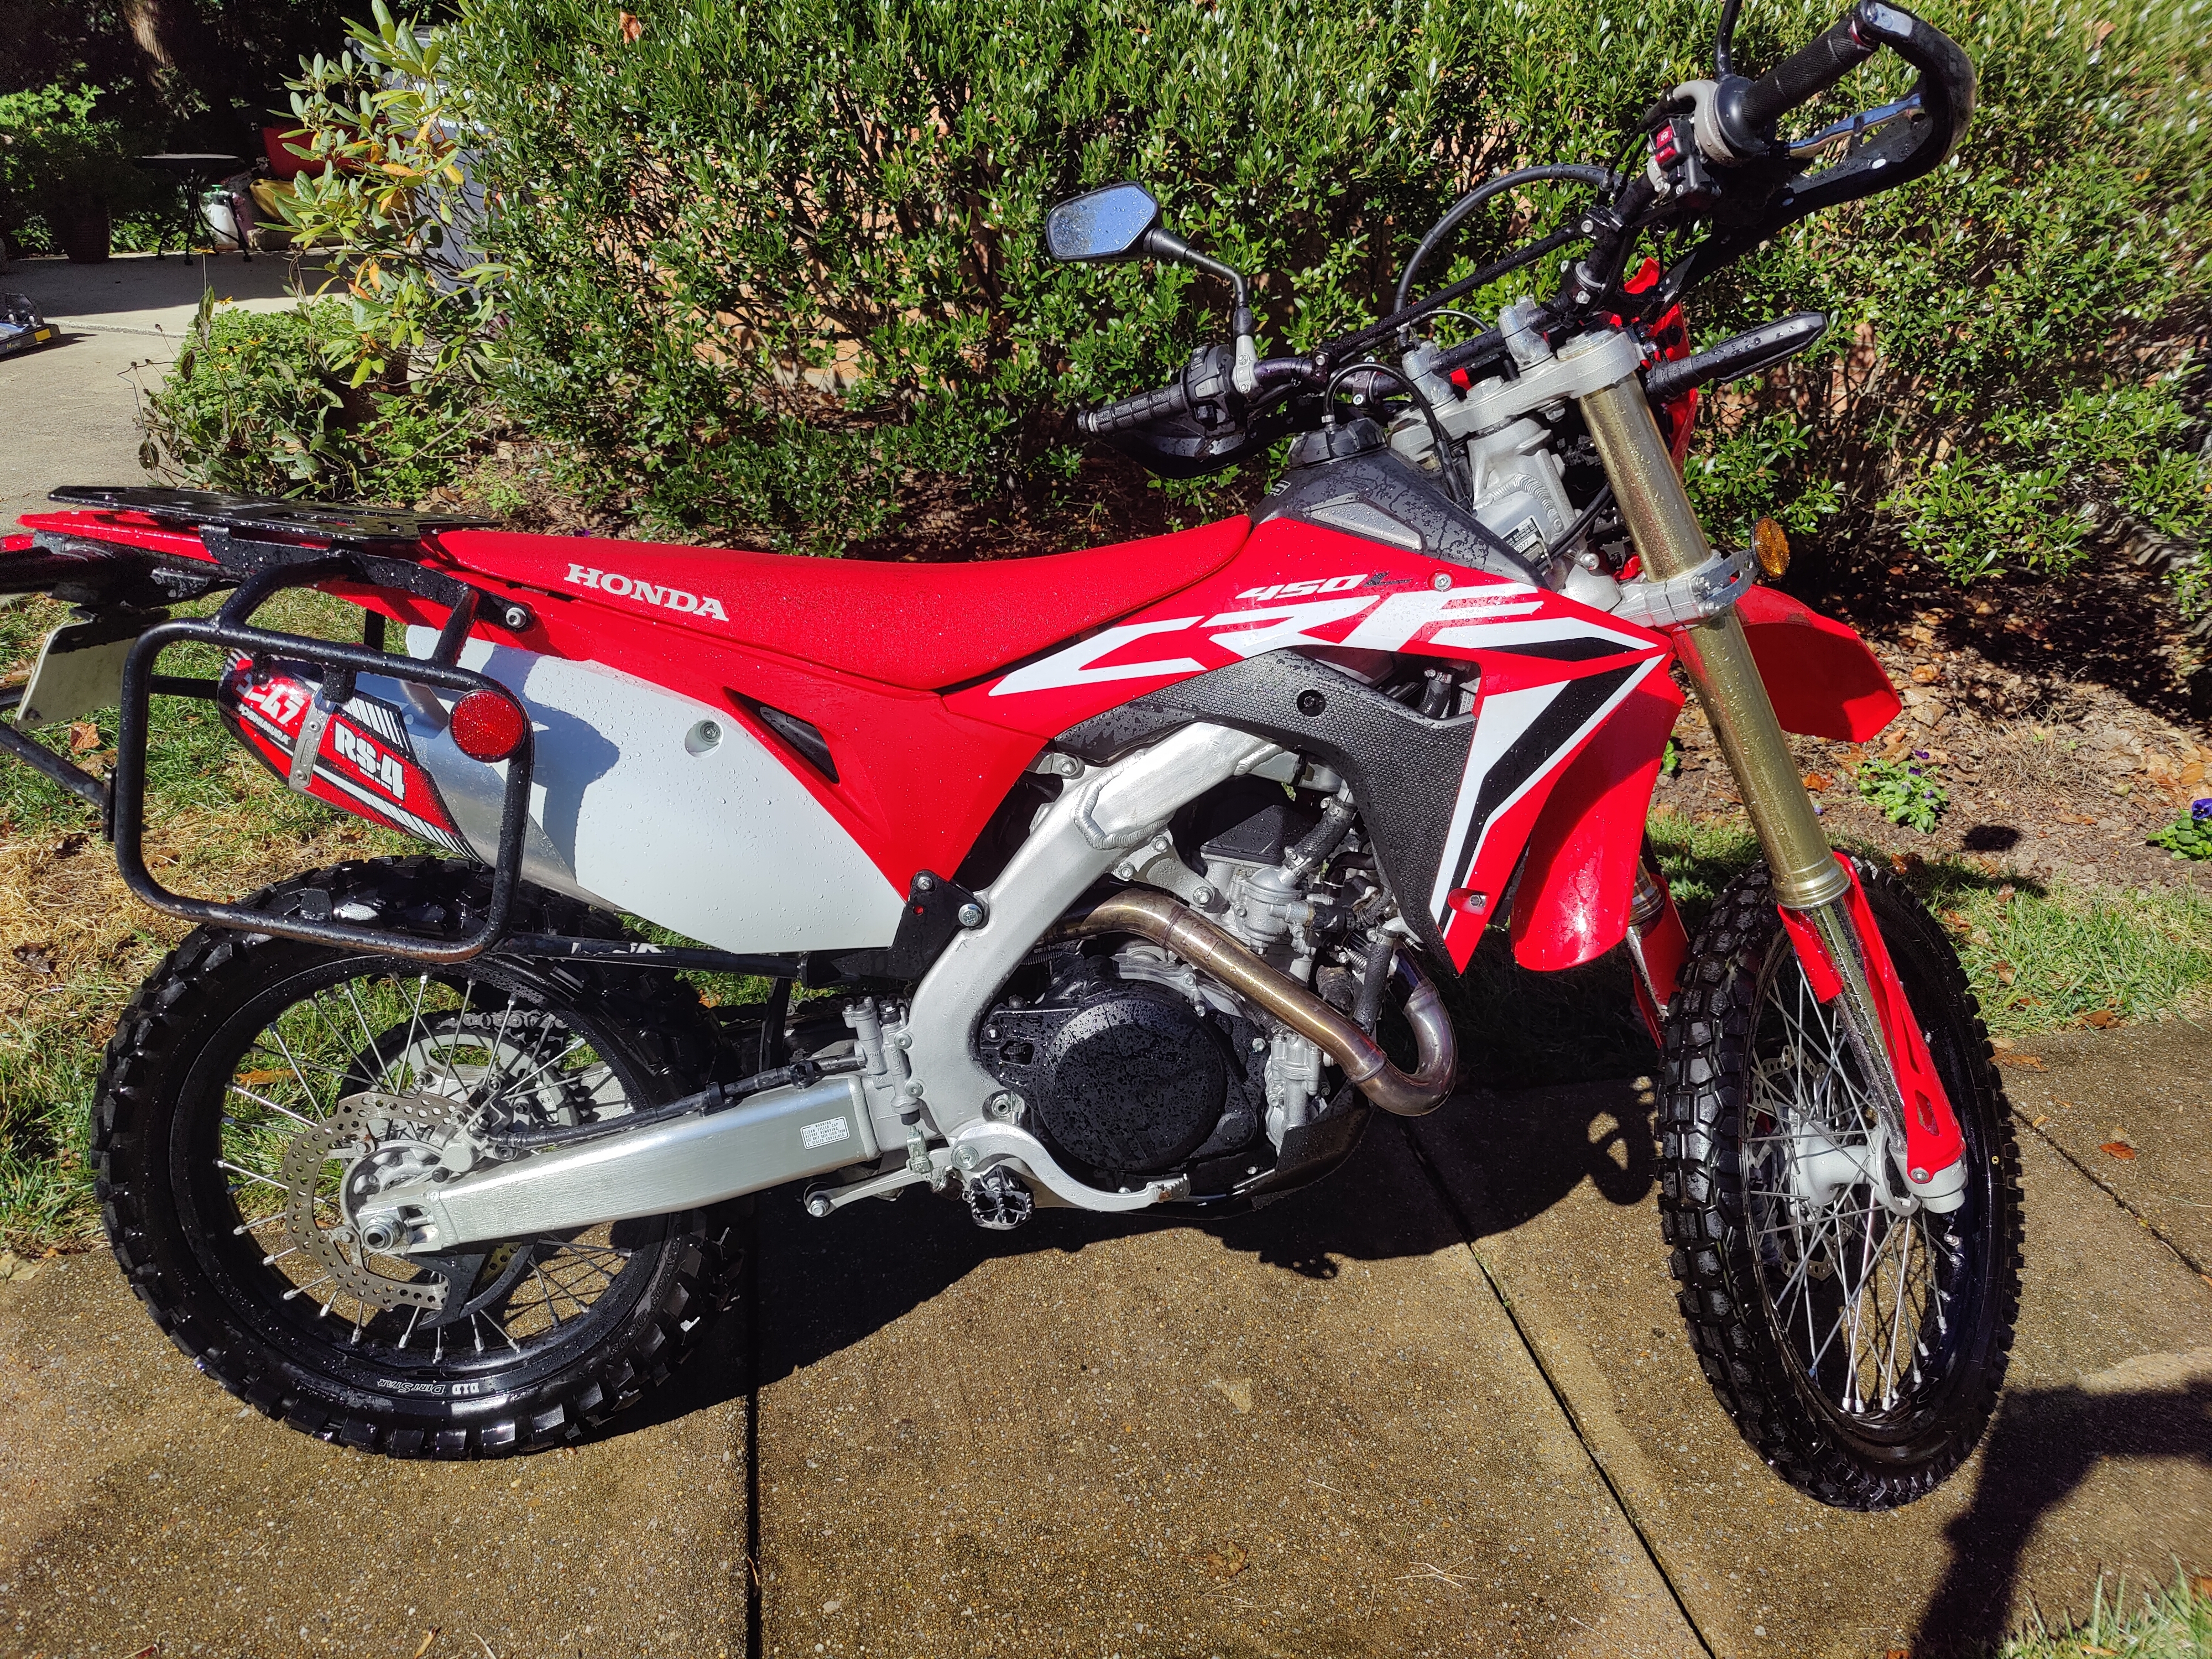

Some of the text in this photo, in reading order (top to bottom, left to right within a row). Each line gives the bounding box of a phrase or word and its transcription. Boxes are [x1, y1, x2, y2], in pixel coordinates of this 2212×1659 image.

[564, 563, 729, 622] HONDA
[989, 582, 1543, 696] CRF
[335, 721, 405, 800] RS-4
[866, 1048, 885, 1058] LOWER
